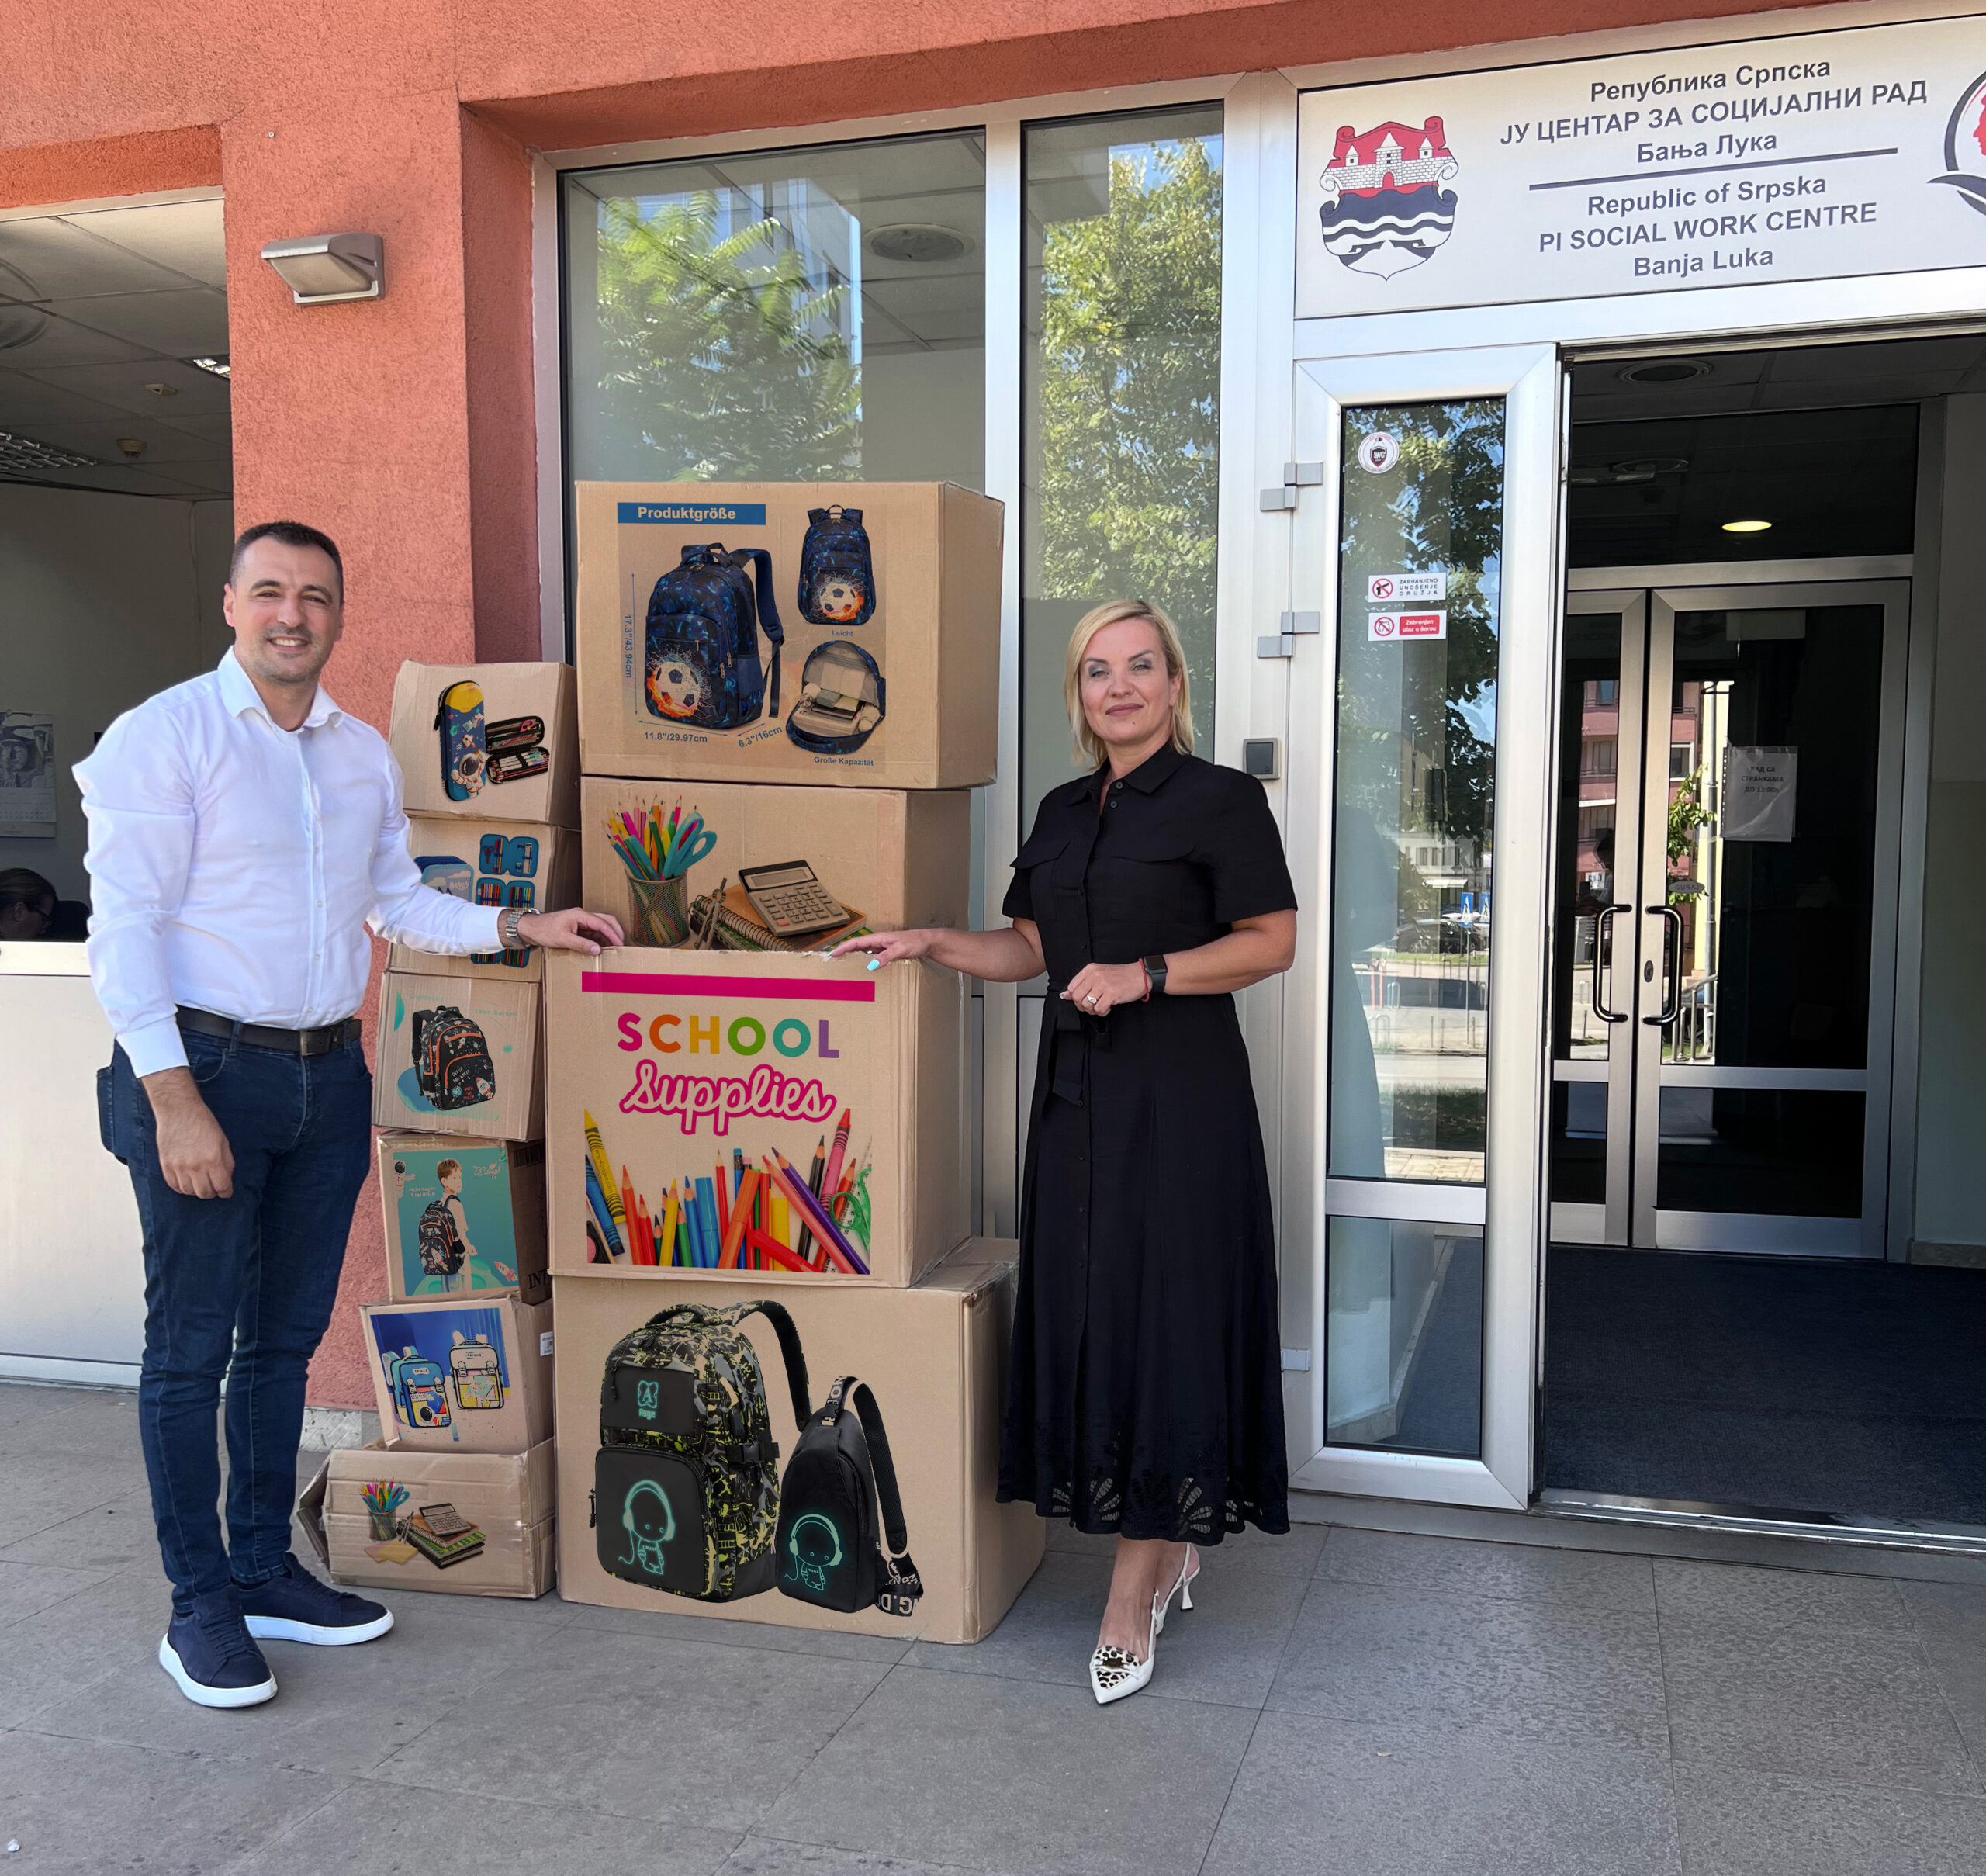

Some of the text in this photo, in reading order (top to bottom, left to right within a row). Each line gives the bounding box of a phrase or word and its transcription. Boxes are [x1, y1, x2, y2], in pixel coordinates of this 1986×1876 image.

[1591, 62, 1831, 102] Република Српска
[1500, 80, 1927, 145] ЈУ ЦЕНТАР ЗА СОЦИЈАЛНИ РАД
[1638, 133, 1777, 164] Бања Лука
[1588, 175, 1827, 218] Republic of Srpska
[1539, 202, 1877, 253] PI SOCIAL WORK CENTRE
[1634, 247, 1773, 279] Banja Luka
[638, 506, 736, 522] Produktgröße
[644, 732, 708, 743] 11.8"/29.97cm
[738, 727, 783, 749] 6.3"/16cm
[839, 758, 874, 767] Kapazität
[617, 1012, 840, 1058] SCHOOL
[619, 1059, 836, 1136] Supplies
